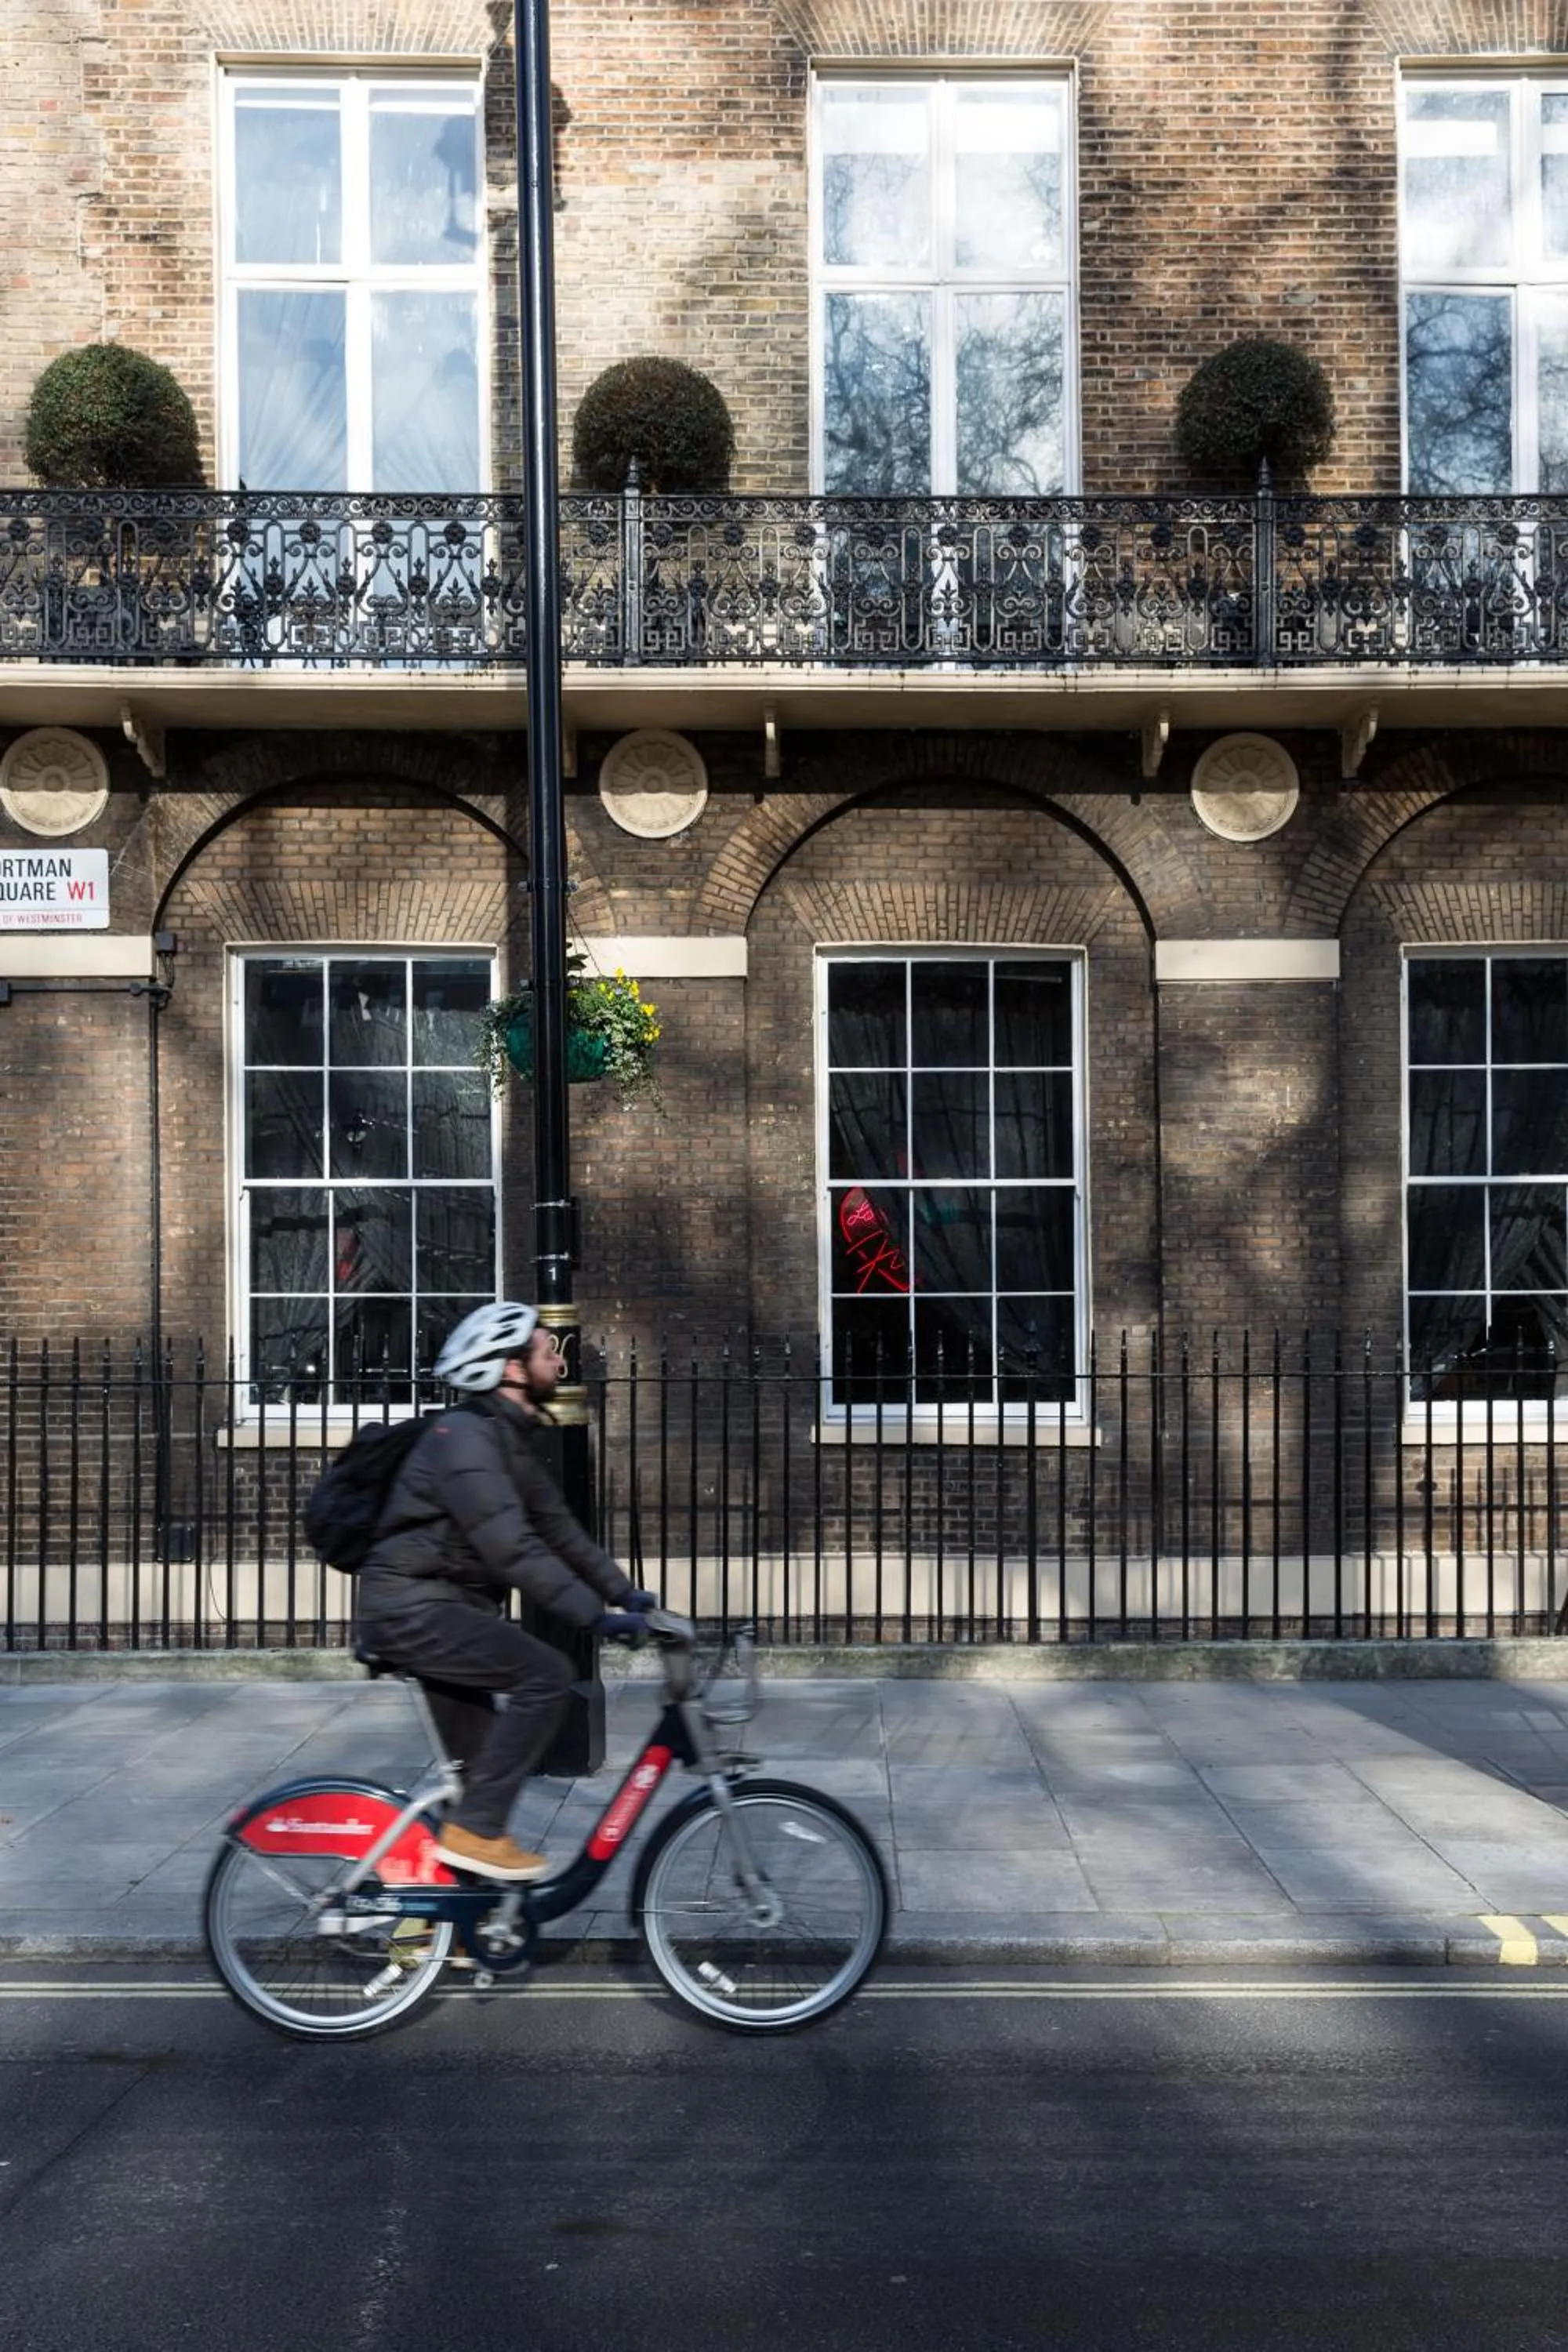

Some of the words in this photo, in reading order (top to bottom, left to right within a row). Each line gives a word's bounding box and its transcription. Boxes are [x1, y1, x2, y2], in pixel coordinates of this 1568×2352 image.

[0, 858, 71, 877] RTMAN
[67, 880, 94, 901] W1
[16, 913, 82, 924] WESTMINSTER
[548, 1266, 556, 1281] 1
